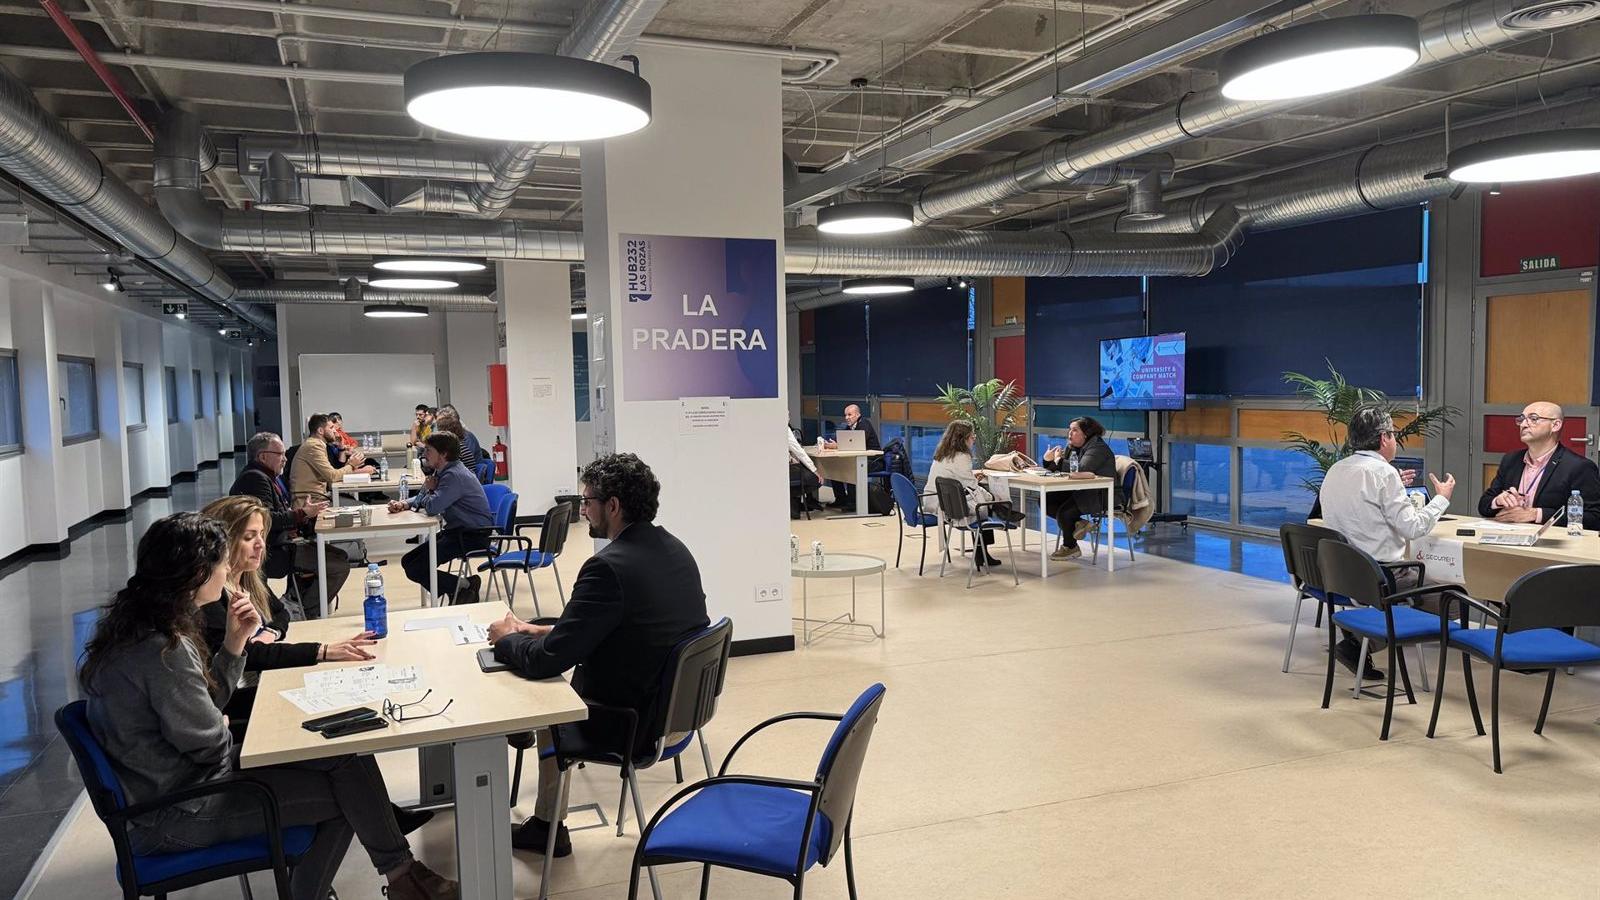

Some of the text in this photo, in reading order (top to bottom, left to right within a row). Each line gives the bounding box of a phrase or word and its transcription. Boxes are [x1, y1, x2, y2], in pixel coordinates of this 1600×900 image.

[627, 240, 638, 291] HUB232
[638, 240, 647, 291] LAS ROZAS
[1522, 258, 1556, 270] SALIDA
[682, 294, 718, 316] LA
[632, 328, 767, 350] PRADERA
